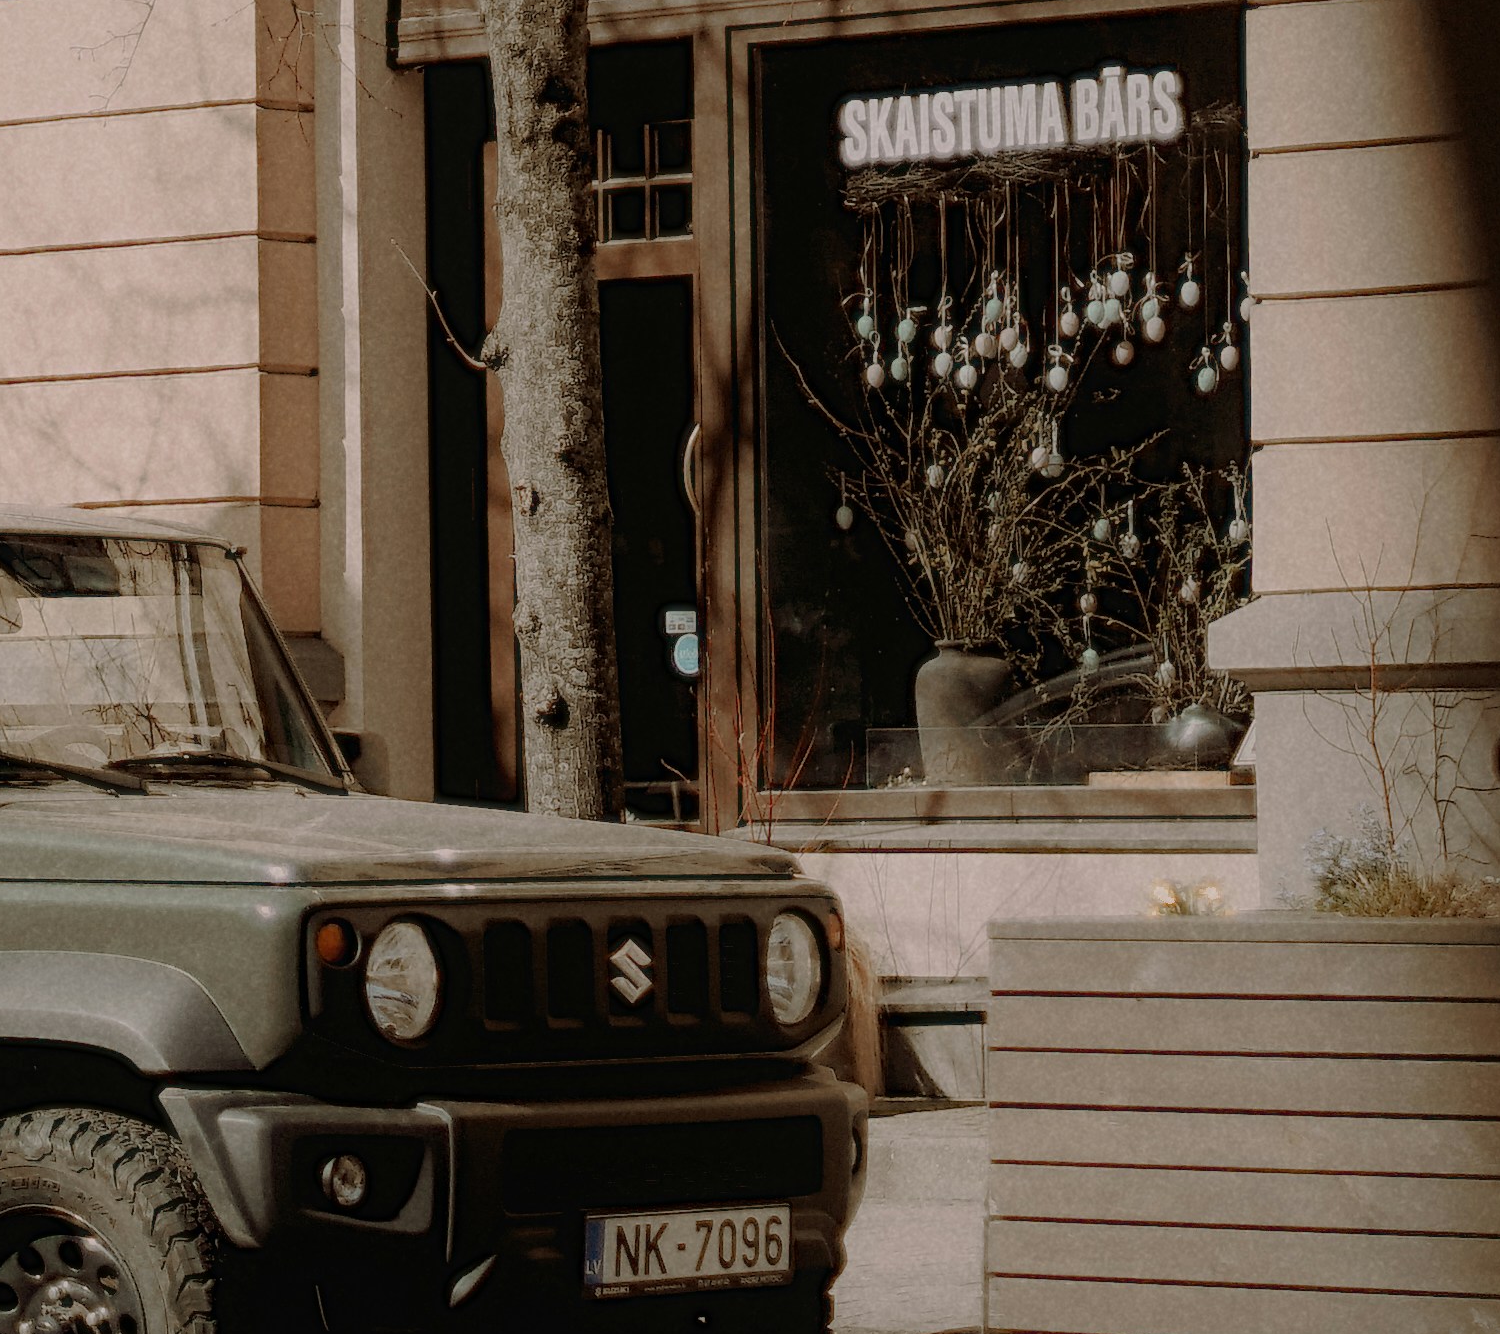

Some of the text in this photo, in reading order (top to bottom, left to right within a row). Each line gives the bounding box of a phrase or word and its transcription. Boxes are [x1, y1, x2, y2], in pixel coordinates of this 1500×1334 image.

[844, 66, 1179, 162] SKAISTUMA BĀRS
[585, 1259, 601, 1276] LV
[615, 1215, 783, 1277] NK-7096
